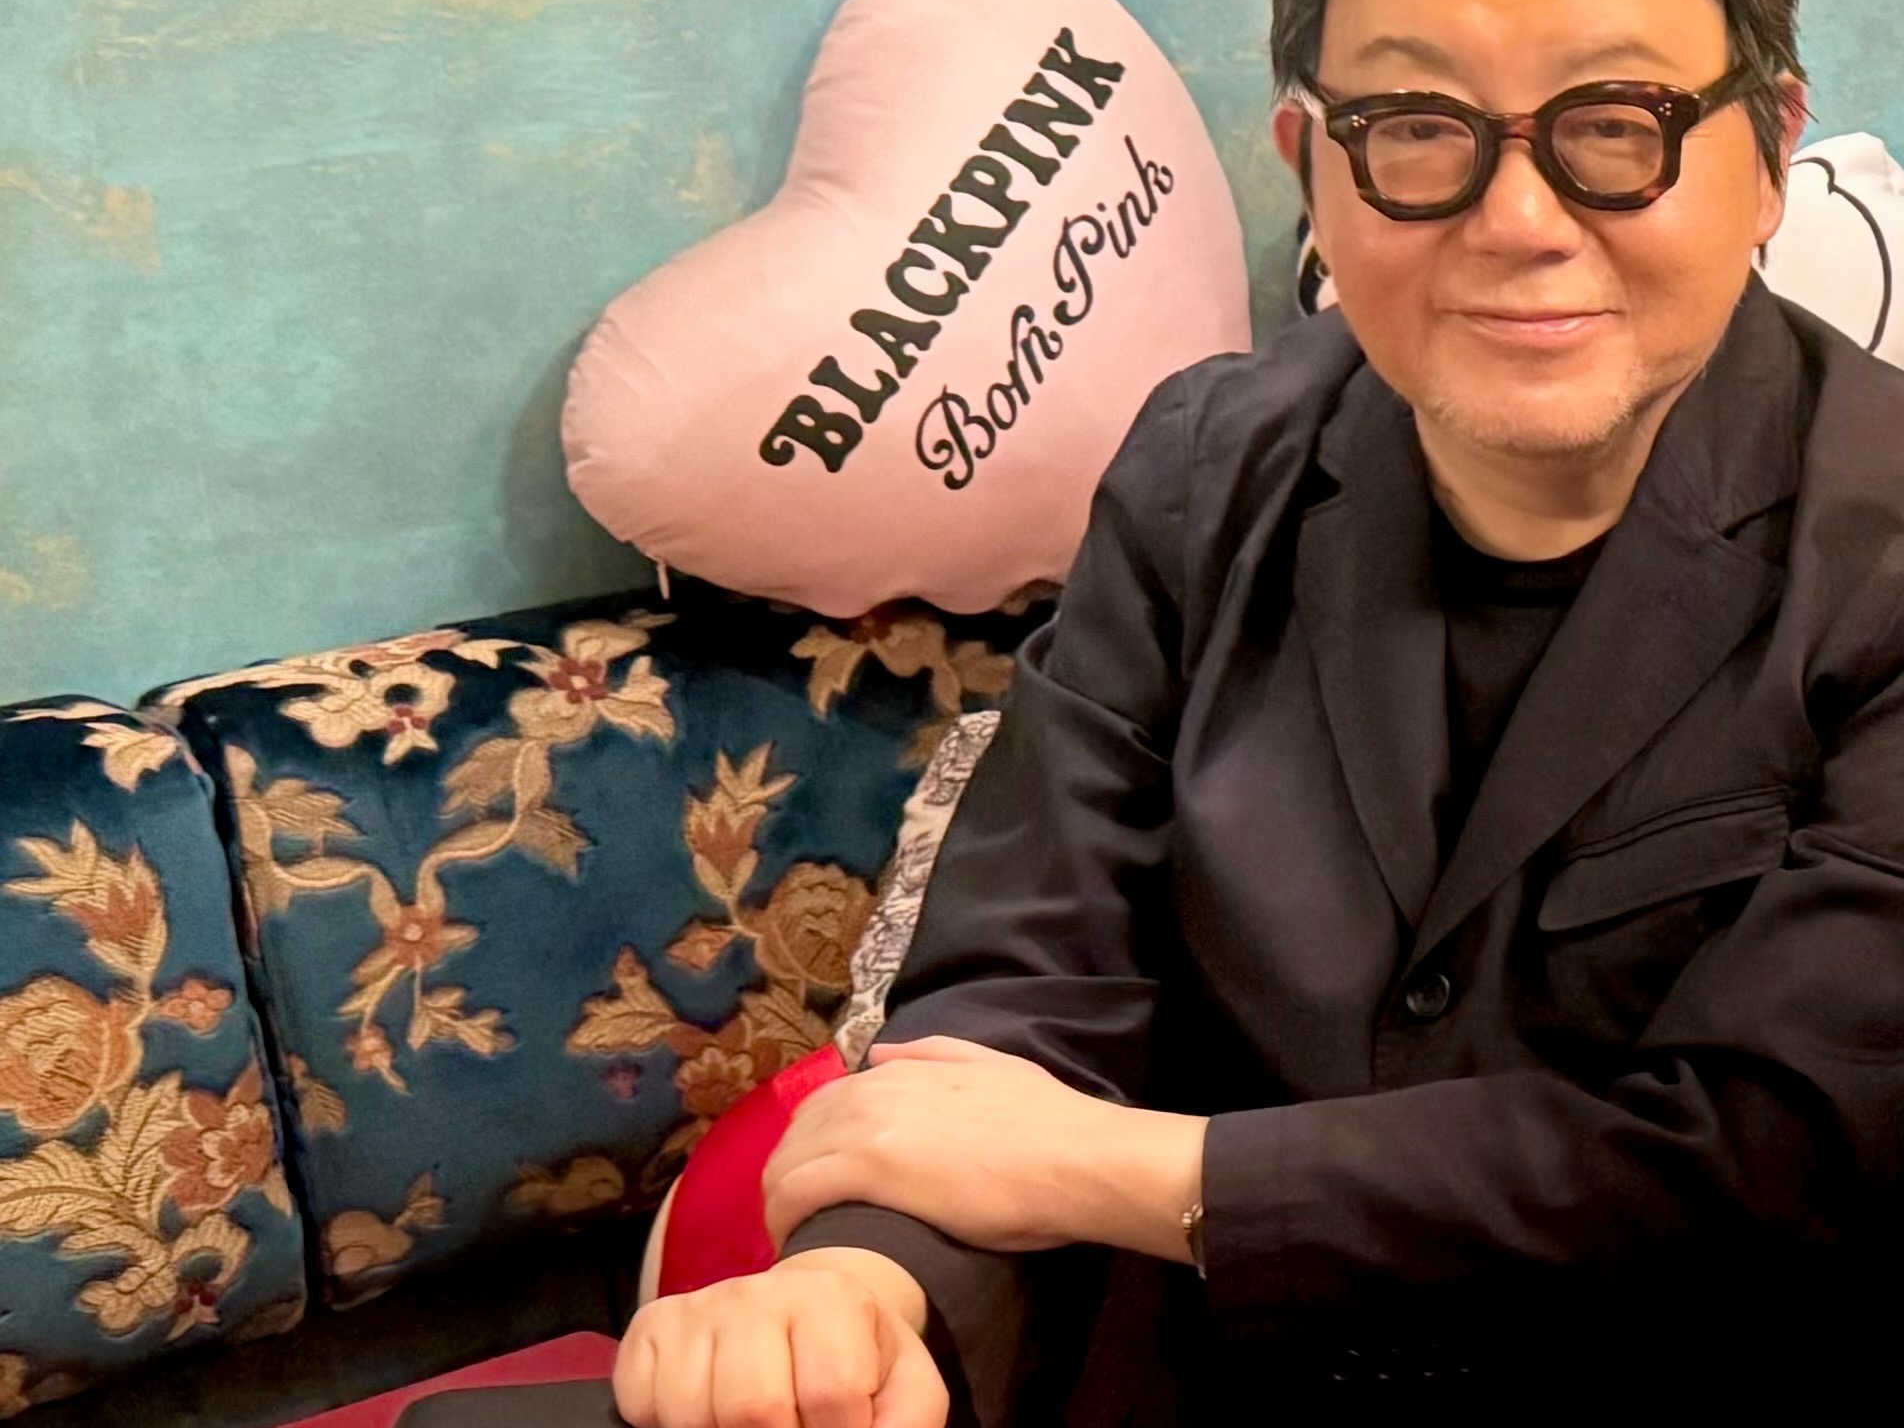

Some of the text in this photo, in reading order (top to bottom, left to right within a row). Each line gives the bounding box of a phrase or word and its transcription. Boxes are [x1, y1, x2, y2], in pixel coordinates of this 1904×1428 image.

[759, 26, 1126, 473] BLACKPINK
[914, 134, 1175, 491] Born Pink
